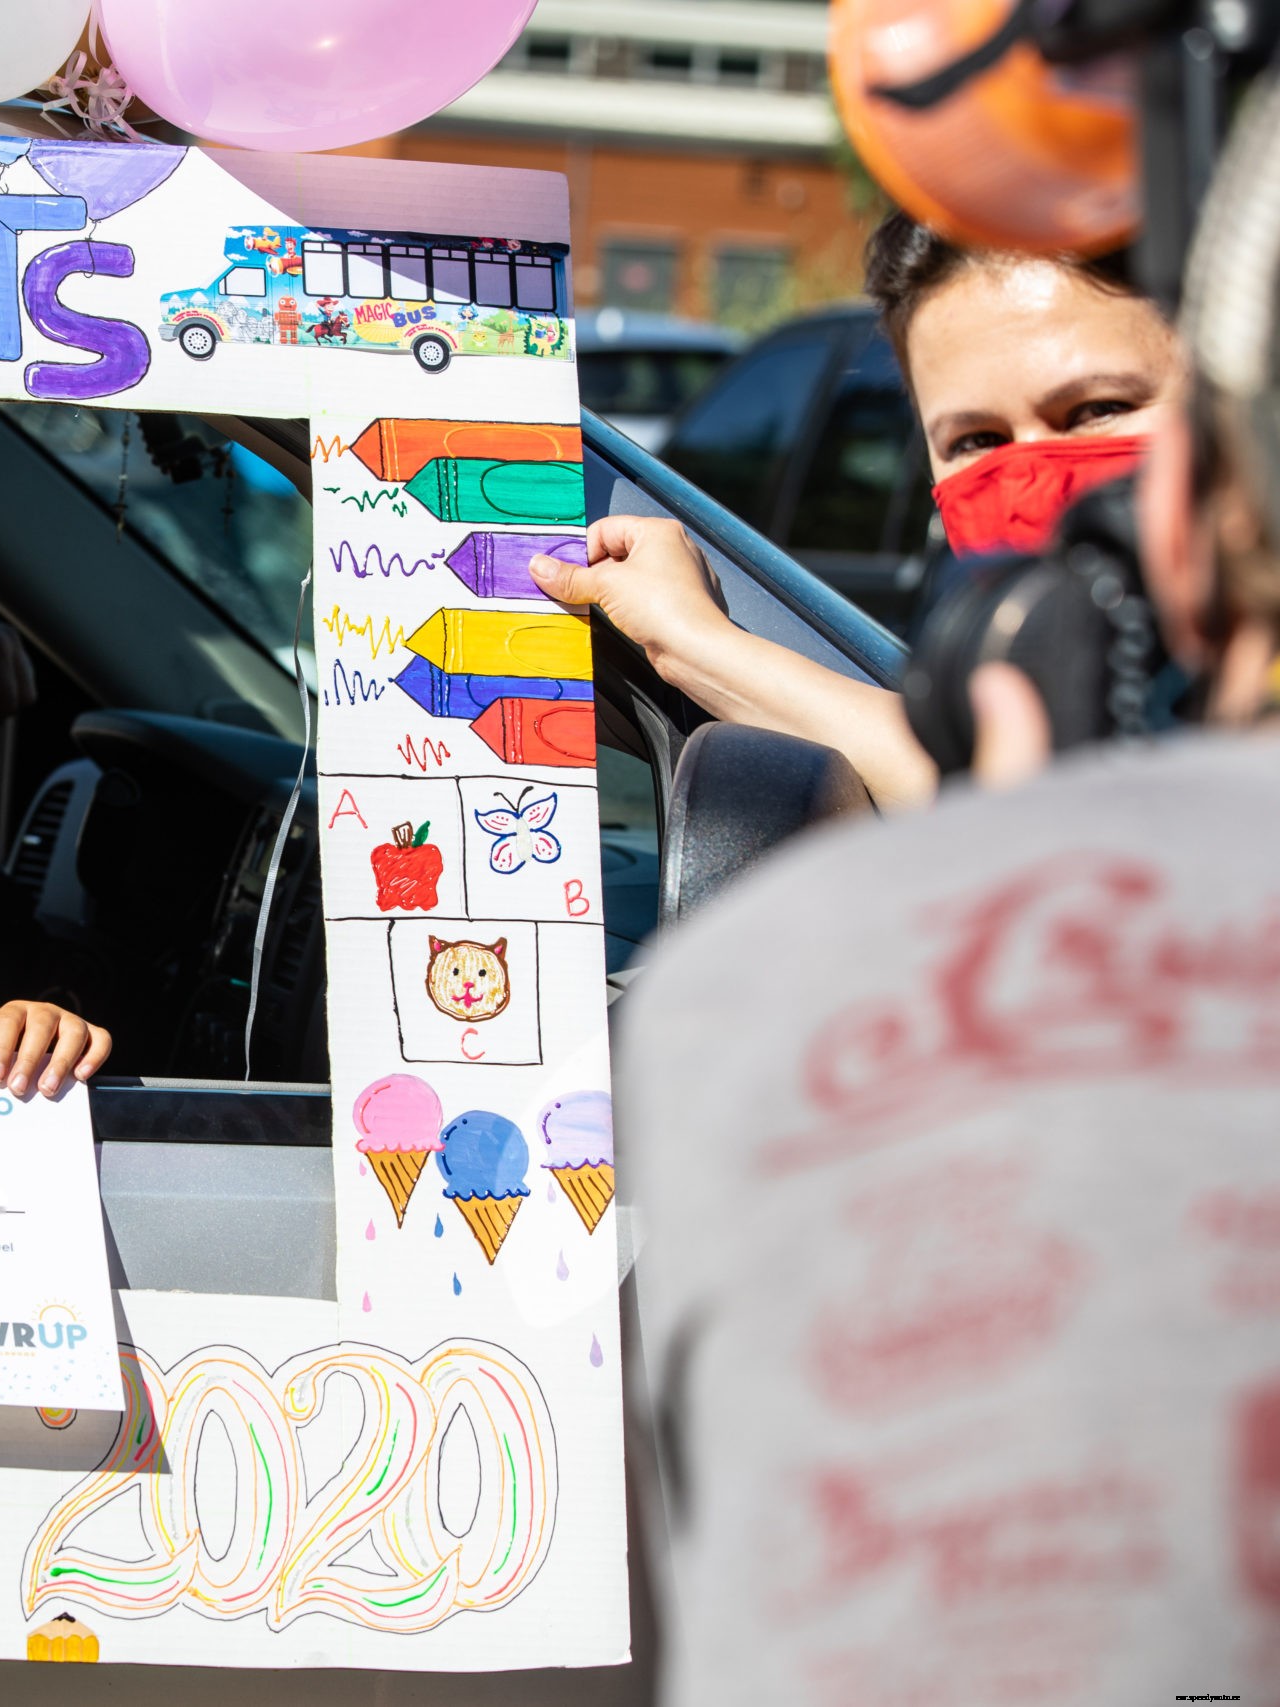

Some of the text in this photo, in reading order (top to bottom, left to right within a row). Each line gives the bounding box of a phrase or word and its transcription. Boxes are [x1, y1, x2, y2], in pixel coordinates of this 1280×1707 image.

[354, 302, 437, 328] MAGIC BUS
[327, 788, 369, 830] A
[563, 878, 591, 917] B
[460, 1027, 486, 1061] C
[19, 1336, 559, 1635] 2020
